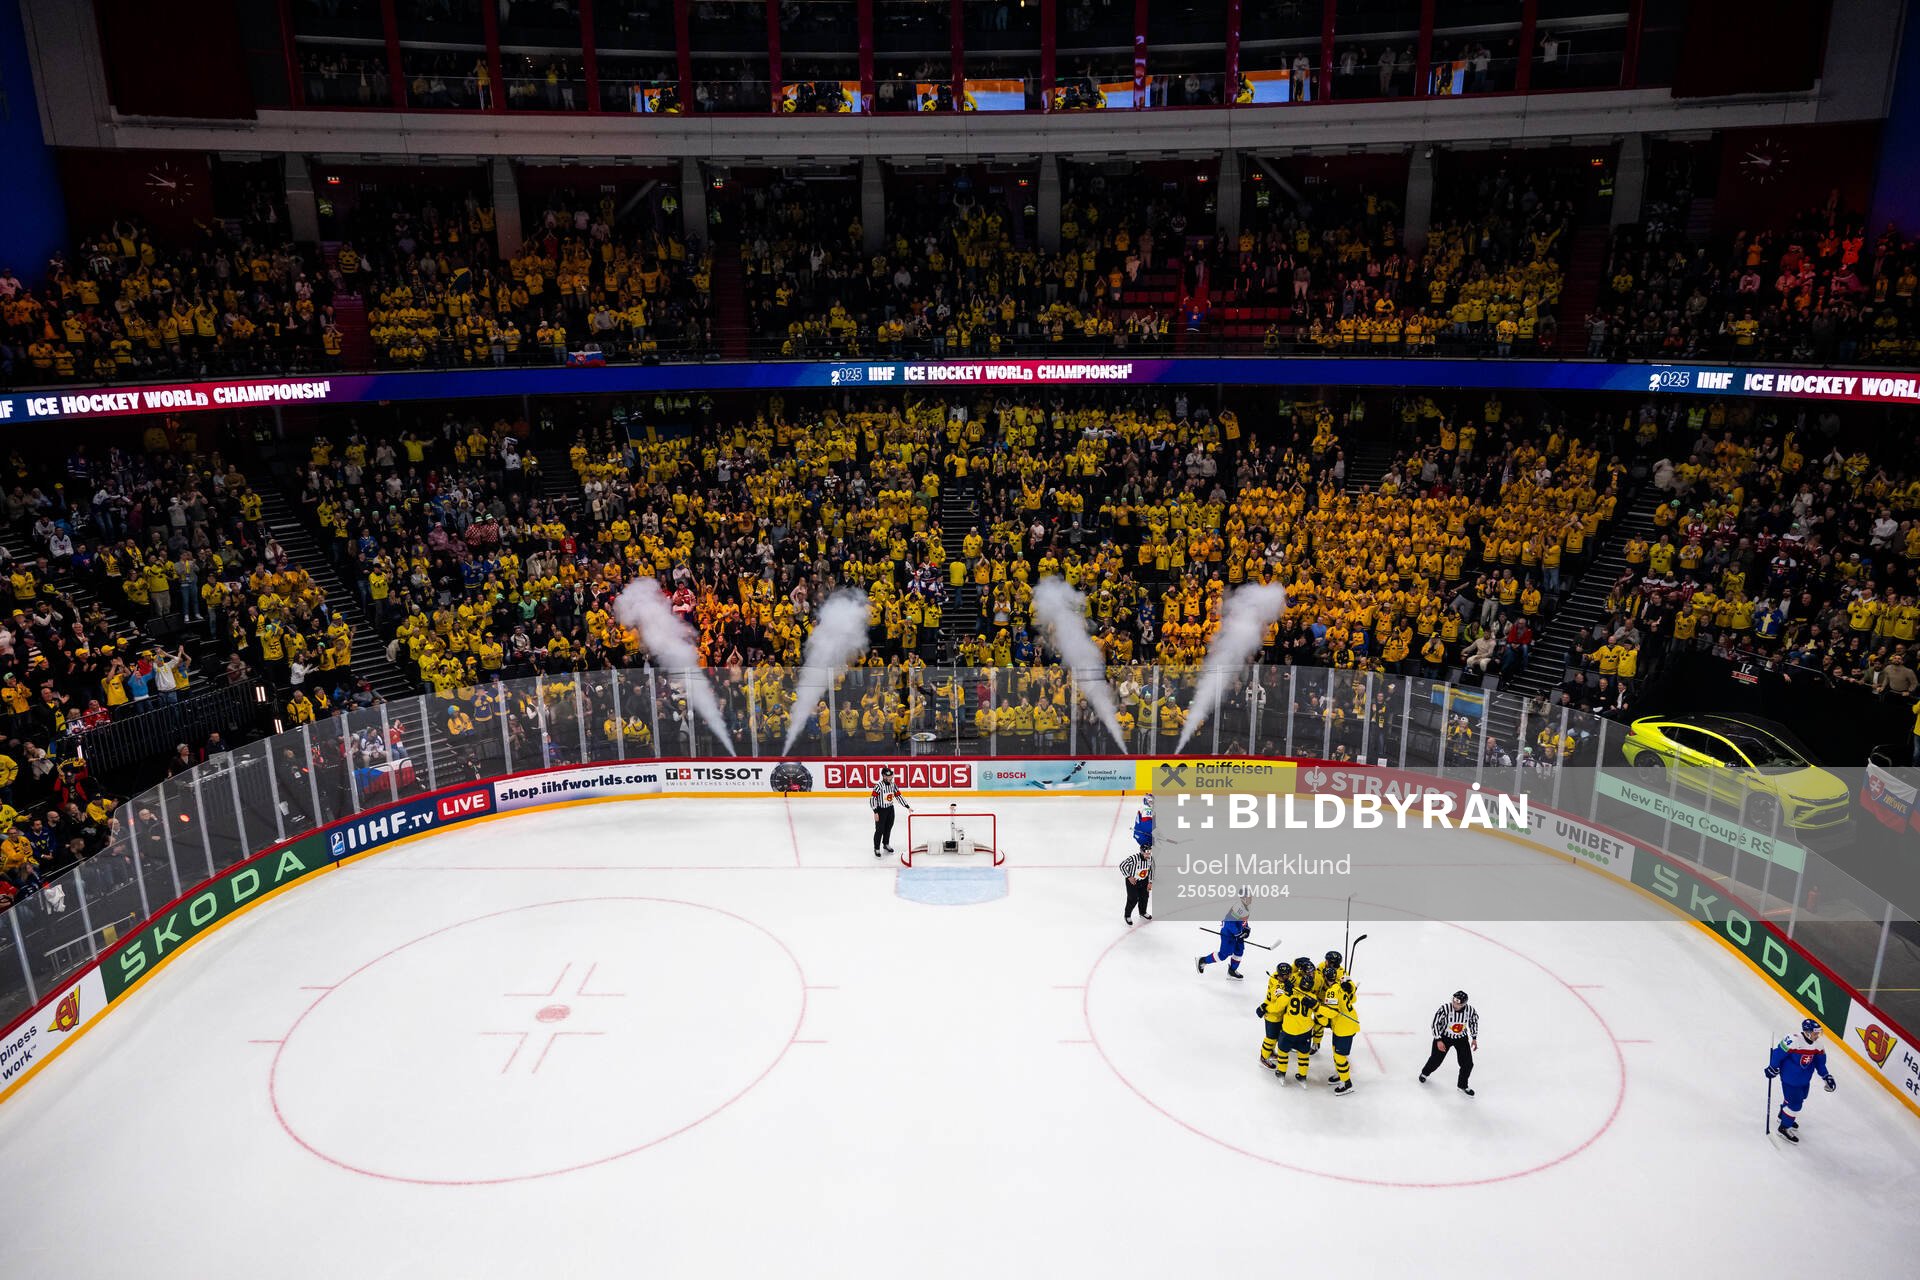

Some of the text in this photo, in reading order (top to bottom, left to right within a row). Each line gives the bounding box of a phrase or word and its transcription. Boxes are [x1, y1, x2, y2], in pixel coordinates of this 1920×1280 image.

[868, 366, 895, 381] IIHF
[904, 366, 925, 381] ICE
[928, 365, 985, 381] HOCKEY
[1697, 372, 1734, 390] IIHF
[1744, 373, 1774, 392] ICE
[1776, 374, 1858, 396] HOCKEY
[26, 397, 59, 417] ICE
[62, 391, 140, 416] HOCKEY
[693, 768, 763, 780] TISSOT
[828, 766, 969, 785] BAUHAUS
[997, 771, 1026, 779] BOSCH
[1195, 762, 1274, 776] Raiffeisen
[500, 774, 657, 801] shop.iihfworlds.com
[1195, 777, 1234, 788] Bank
[442, 793, 486, 816] LIVE
[1621, 785, 1775, 855] New Enyaq Coupé RS
[1556, 820, 1624, 859] UNIBET
[1905, 1078, 1920, 1096] at
